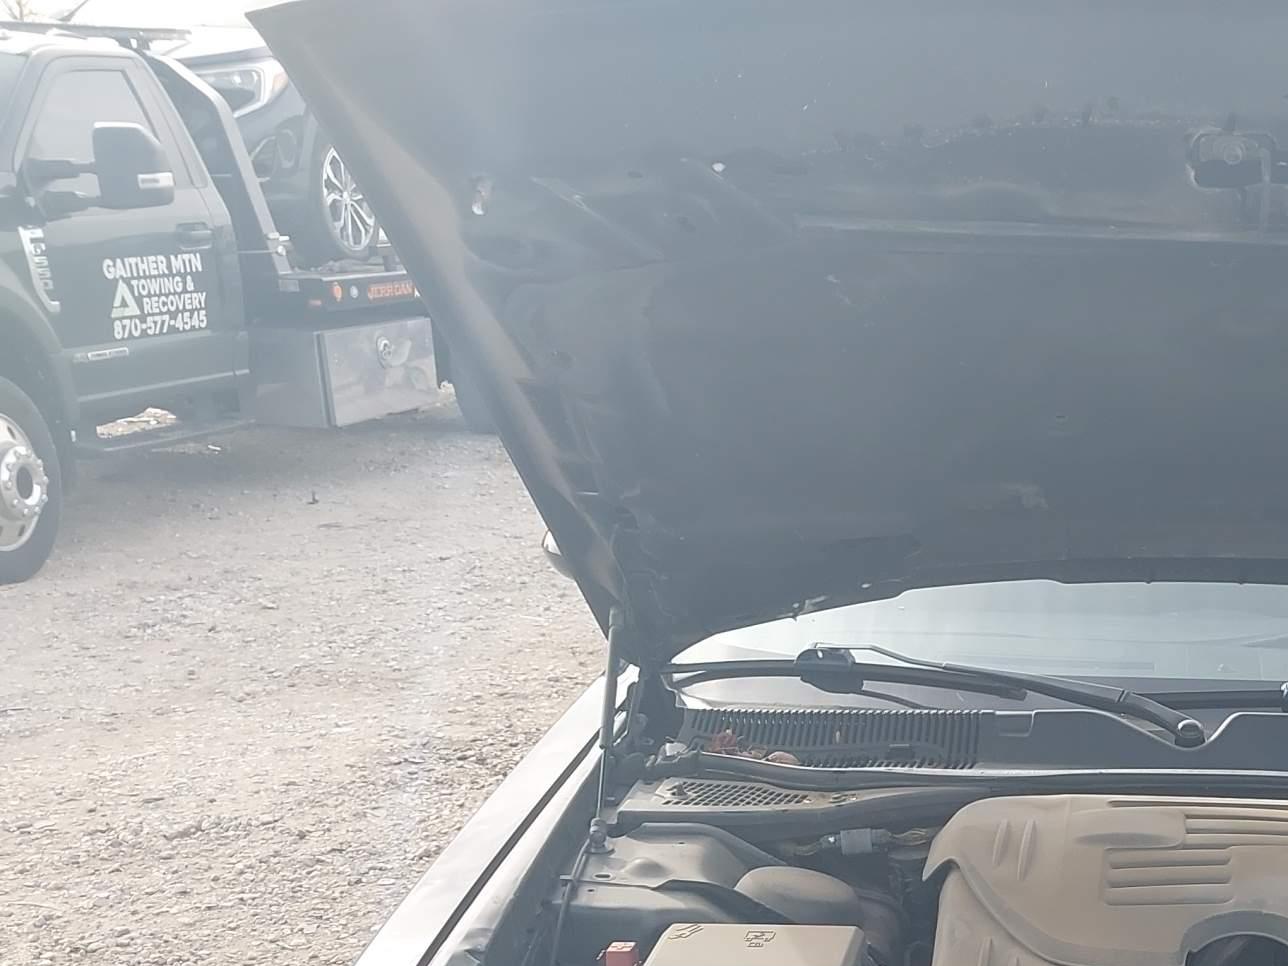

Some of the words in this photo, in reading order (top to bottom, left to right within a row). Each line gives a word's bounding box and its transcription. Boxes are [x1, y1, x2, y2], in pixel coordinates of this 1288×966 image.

[103, 255, 169, 279] GAITHER
[169, 253, 202, 273] MTN
[131, 276, 183, 297] TOWING
[186, 275, 195, 291] &
[143, 292, 206, 314] RECOVERY
[114, 310, 207, 339] 870-577-4545
